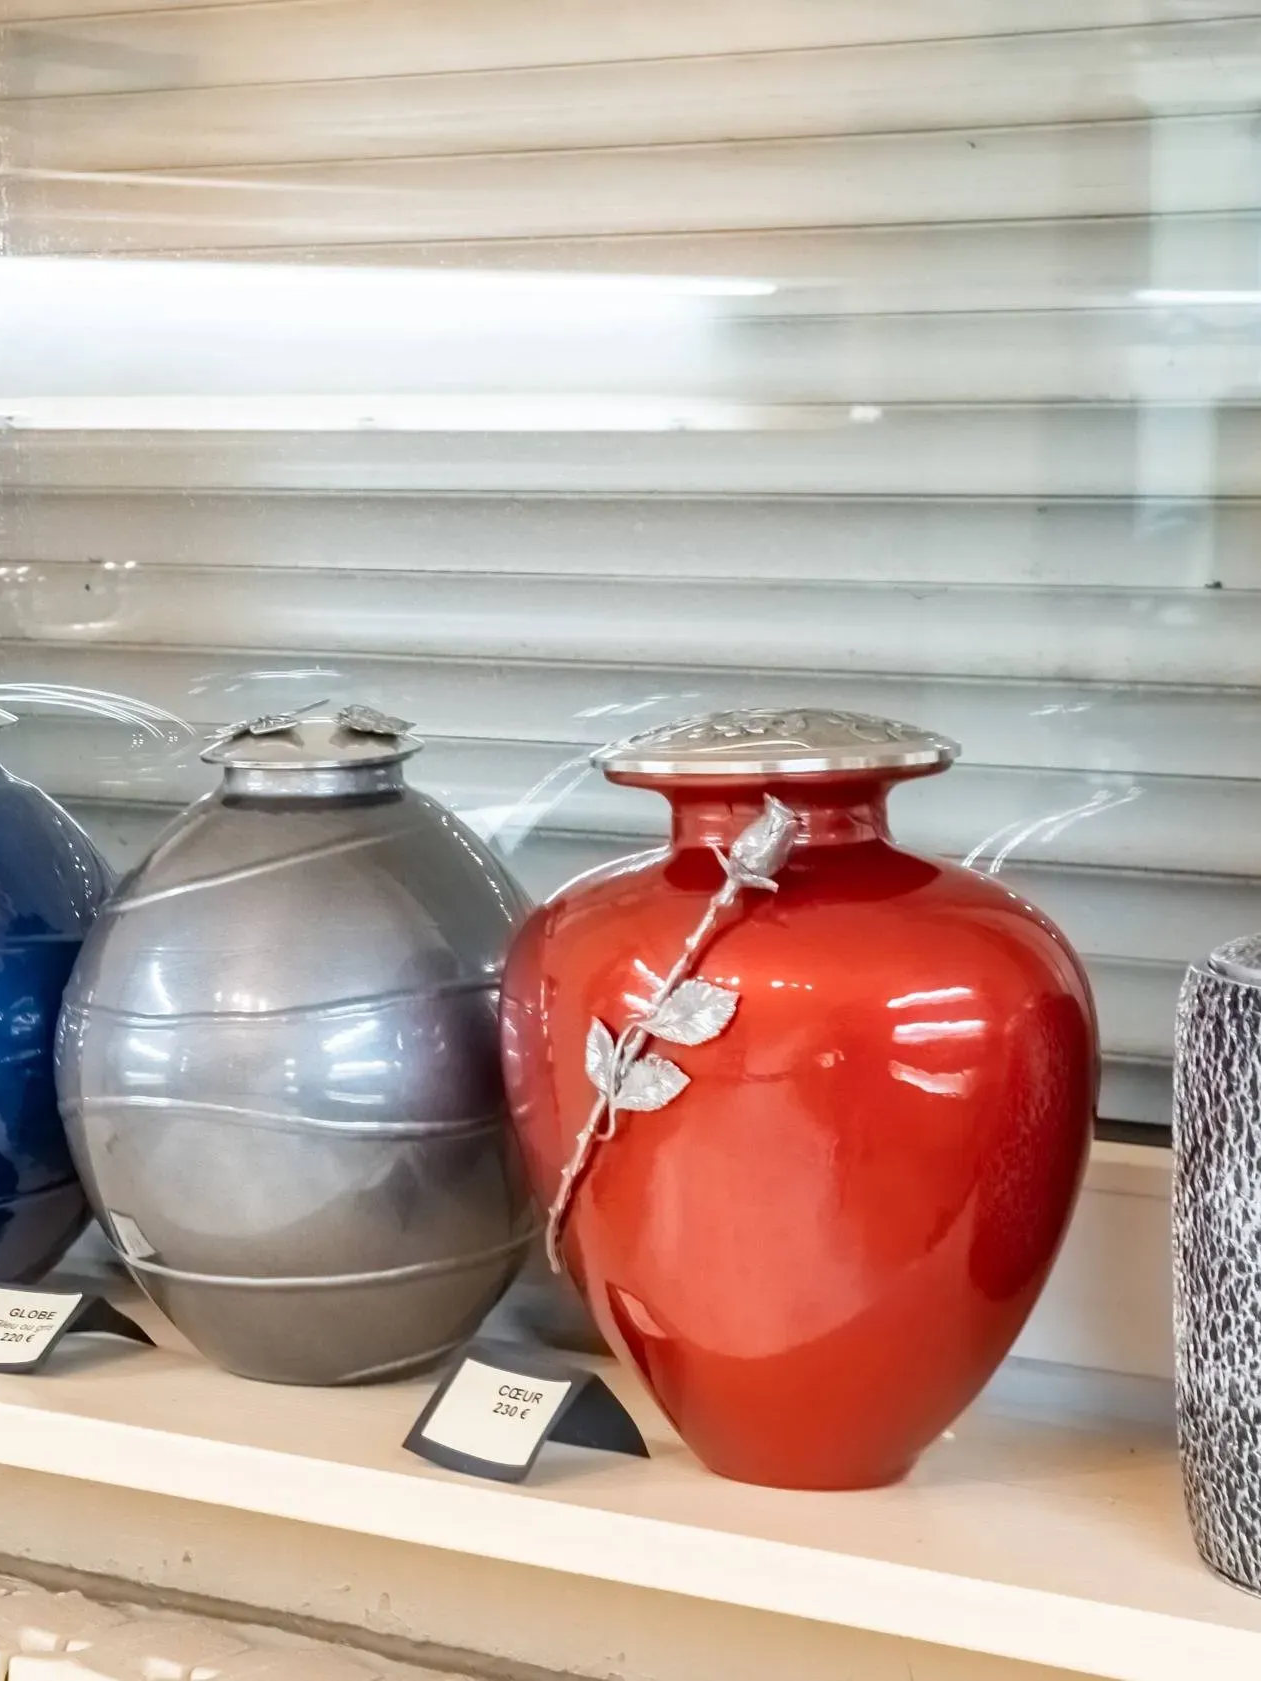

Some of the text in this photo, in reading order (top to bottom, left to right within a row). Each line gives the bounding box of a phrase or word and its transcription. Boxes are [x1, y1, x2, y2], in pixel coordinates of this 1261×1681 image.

[9, 1308, 57, 1320] GLOBE
[0, 1332, 35, 1343] 220 €
[498, 1385, 543, 1404] CŒUR
[493, 1402, 531, 1420] 230 €
